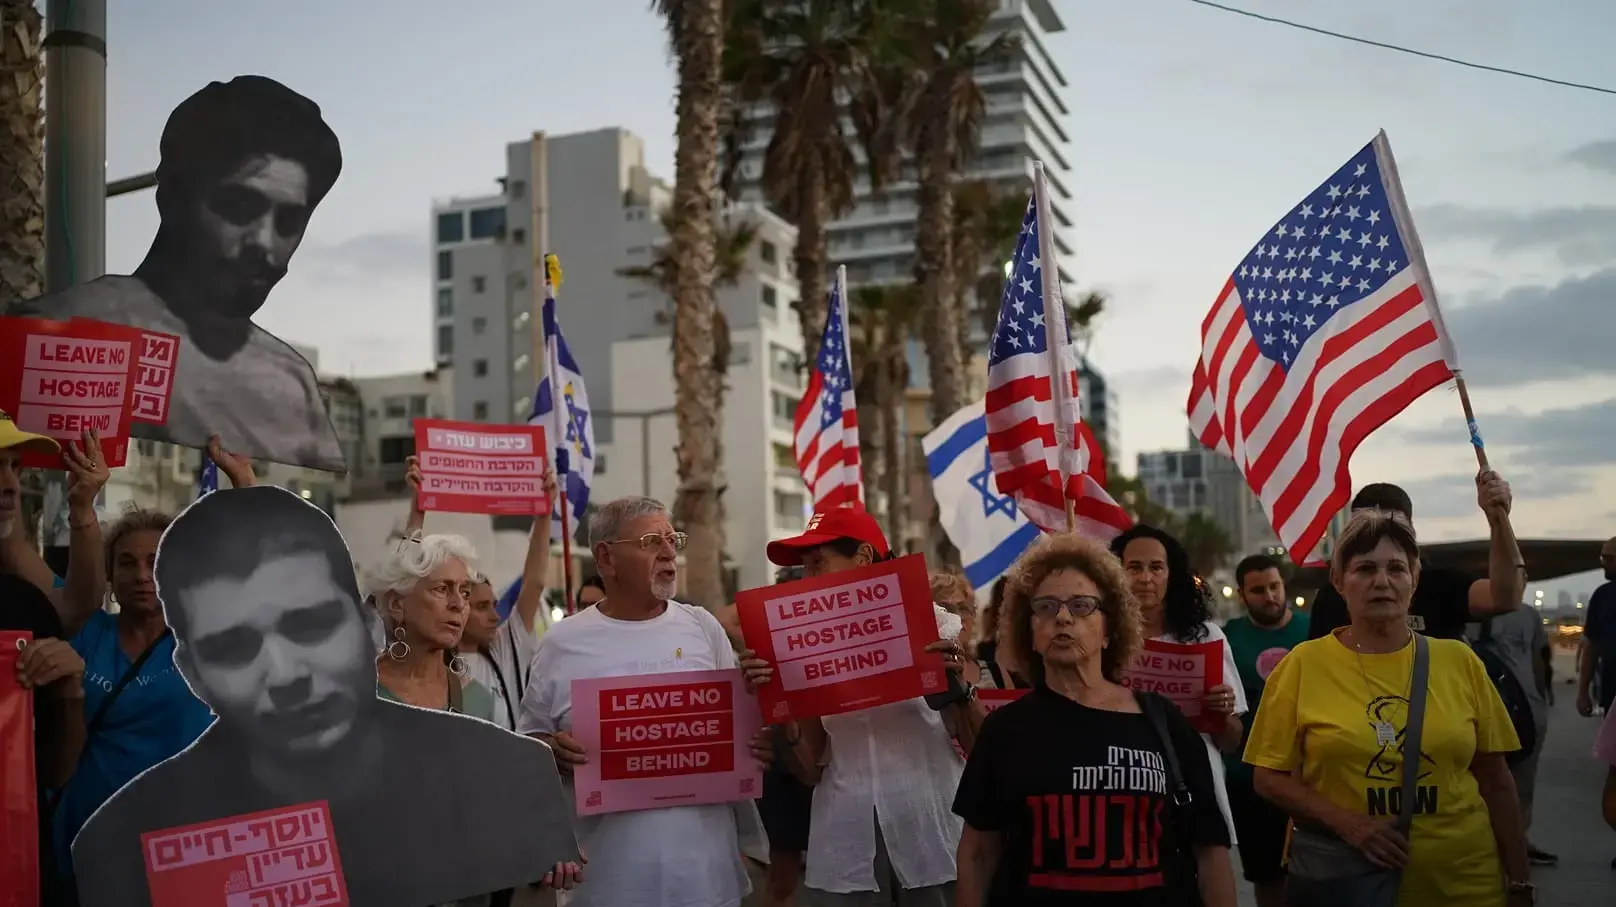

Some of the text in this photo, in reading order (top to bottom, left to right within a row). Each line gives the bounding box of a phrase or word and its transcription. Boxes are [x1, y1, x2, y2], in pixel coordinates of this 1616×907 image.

[39, 343, 125, 365] LEAVE NO
[38, 378, 120, 398] HOSTAGE
[47, 413, 110, 432] BEHIND
[446, 433, 476, 448] עזה
[480, 436, 526, 449] כיבוש
[429, 456, 535, 473] הקרבת החטופים
[430, 477, 535, 493] והקרבת החיילים
[778, 583, 889, 620] LEAVE NO
[787, 614, 893, 651] HOSTAGE
[804, 649, 888, 681] BEHIND
[1168, 659, 1195, 672] NO
[1121, 676, 1193, 694] OSTAGE
[612, 688, 721, 712] LEAVE NO
[615, 719, 720, 742] HOSTAGE
[626, 751, 710, 772] BEHIND
[1073, 765, 1167, 795] אותם הביתה
[1366, 785, 1439, 816] NOW
[154, 811, 321, 866] יוסף-חיים
[252, 843, 328, 883] עדיין
